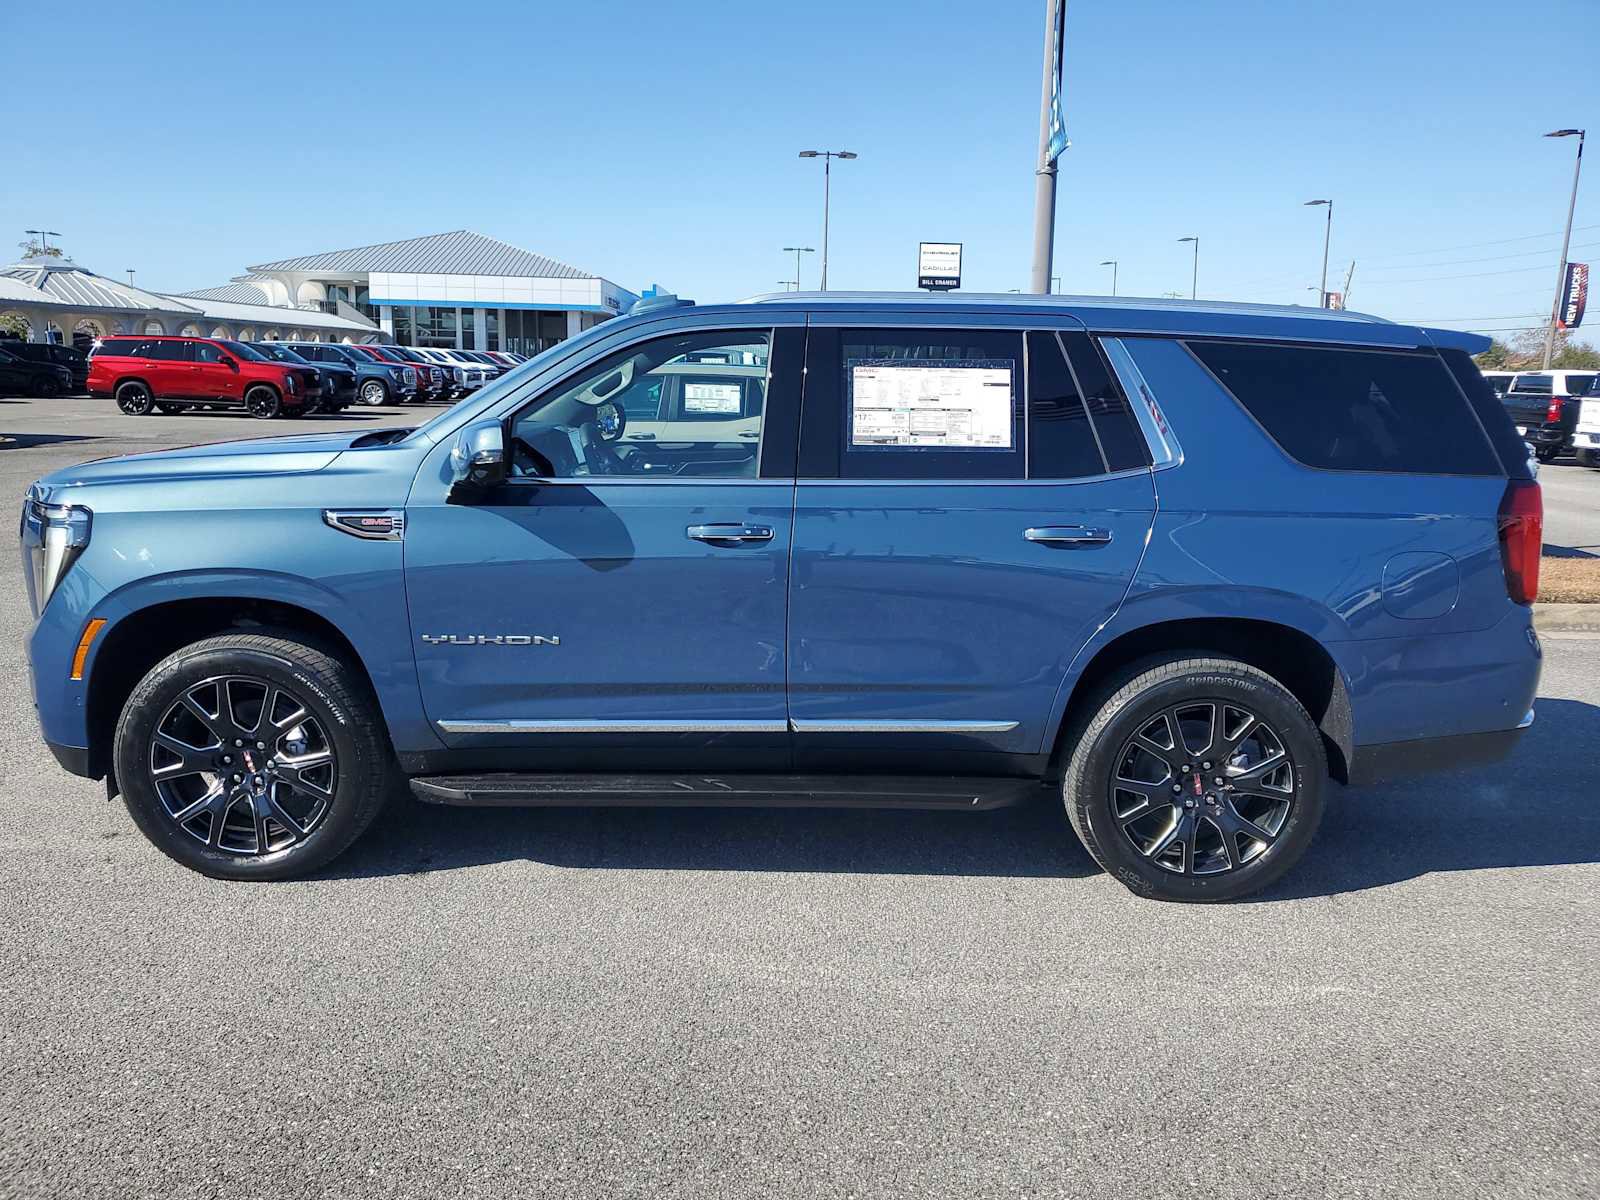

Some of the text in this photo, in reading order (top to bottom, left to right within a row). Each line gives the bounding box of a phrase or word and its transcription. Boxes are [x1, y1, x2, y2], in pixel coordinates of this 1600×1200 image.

[1565, 266, 1582, 326] NEW TRUCKS
[361, 518, 392, 526] GMC
[421, 634, 560, 645] YUKON
